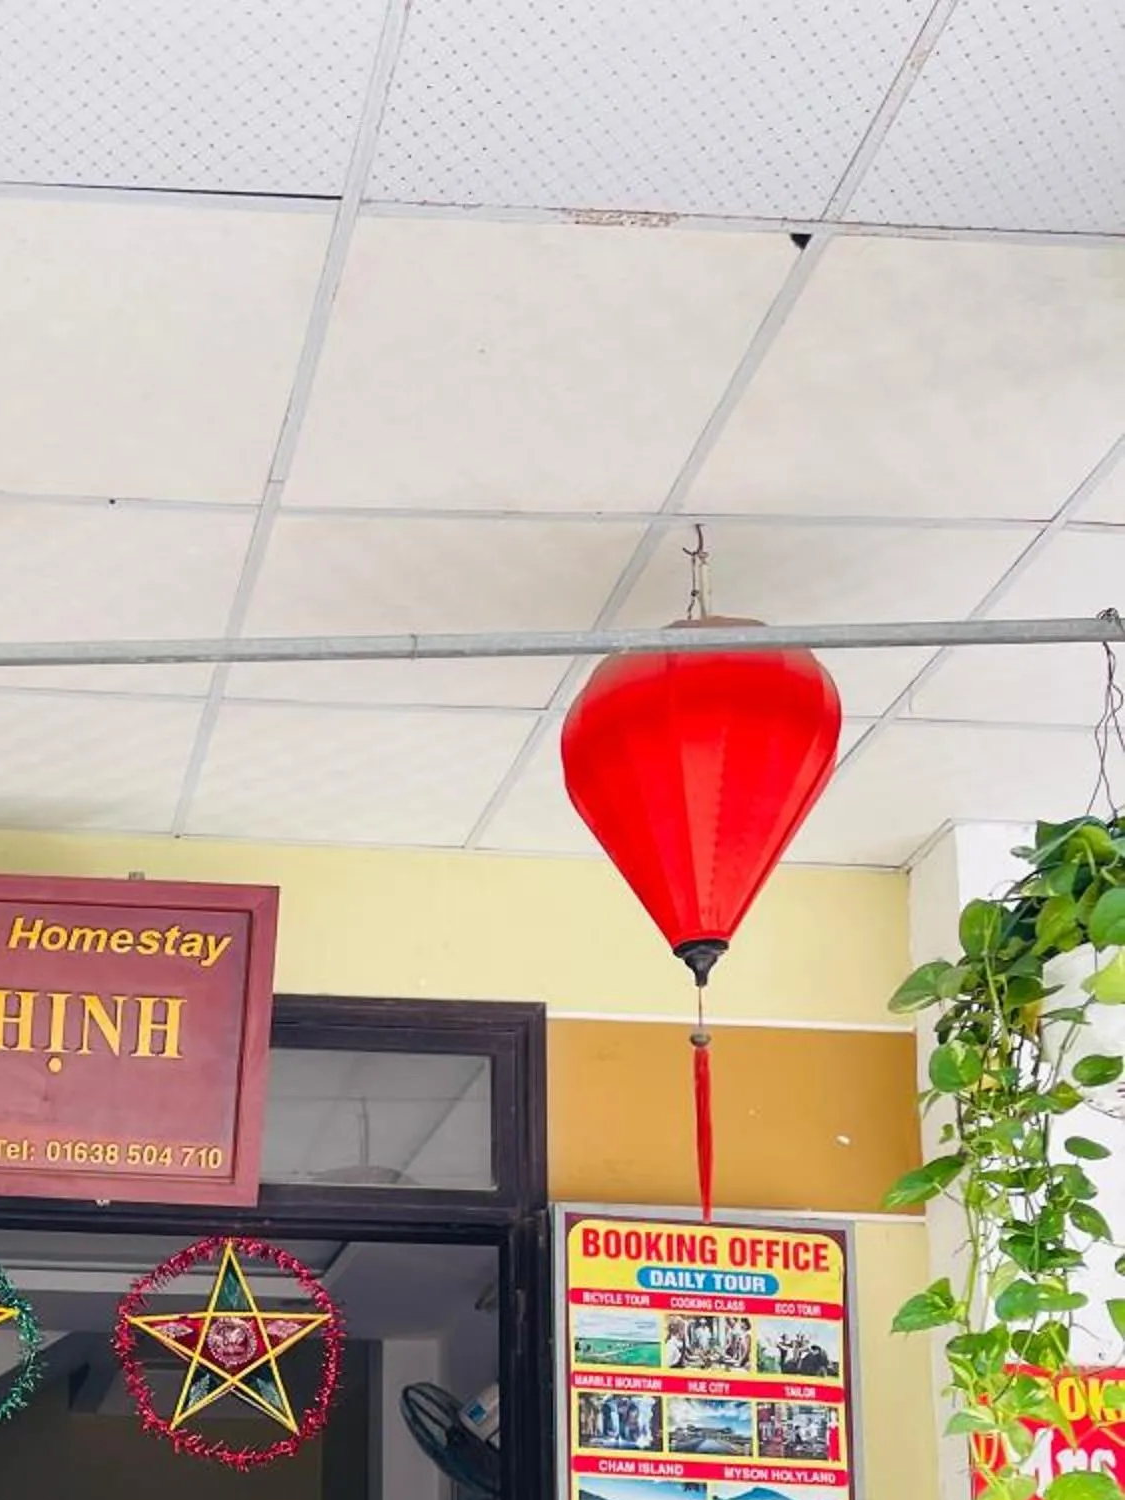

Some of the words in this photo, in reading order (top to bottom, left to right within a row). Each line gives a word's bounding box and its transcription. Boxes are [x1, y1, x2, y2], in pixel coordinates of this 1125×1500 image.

[8, 917, 232, 968] Homestay
[46, 1140, 119, 1166] 01638
[127, 1142, 173, 1167] 504
[181, 1145, 223, 1170] 710
[582, 1227, 717, 1265] BOOKING
[728, 1237, 830, 1273] OFFICE
[649, 1269, 706, 1291] DAILY
[711, 1273, 766, 1293] TOUR
[582, 1291, 623, 1305] BICYCLE
[624, 1294, 650, 1306] TOUR
[670, 1297, 712, 1310] COOKING
[714, 1299, 746, 1311] CLASS
[797, 1303, 821, 1316] TOUR
[598, 1460, 635, 1474] CHAM
[637, 1462, 684, 1476] ISLAND
[724, 1467, 768, 1481] MYSON
[771, 1469, 836, 1484] HOLYLAND
